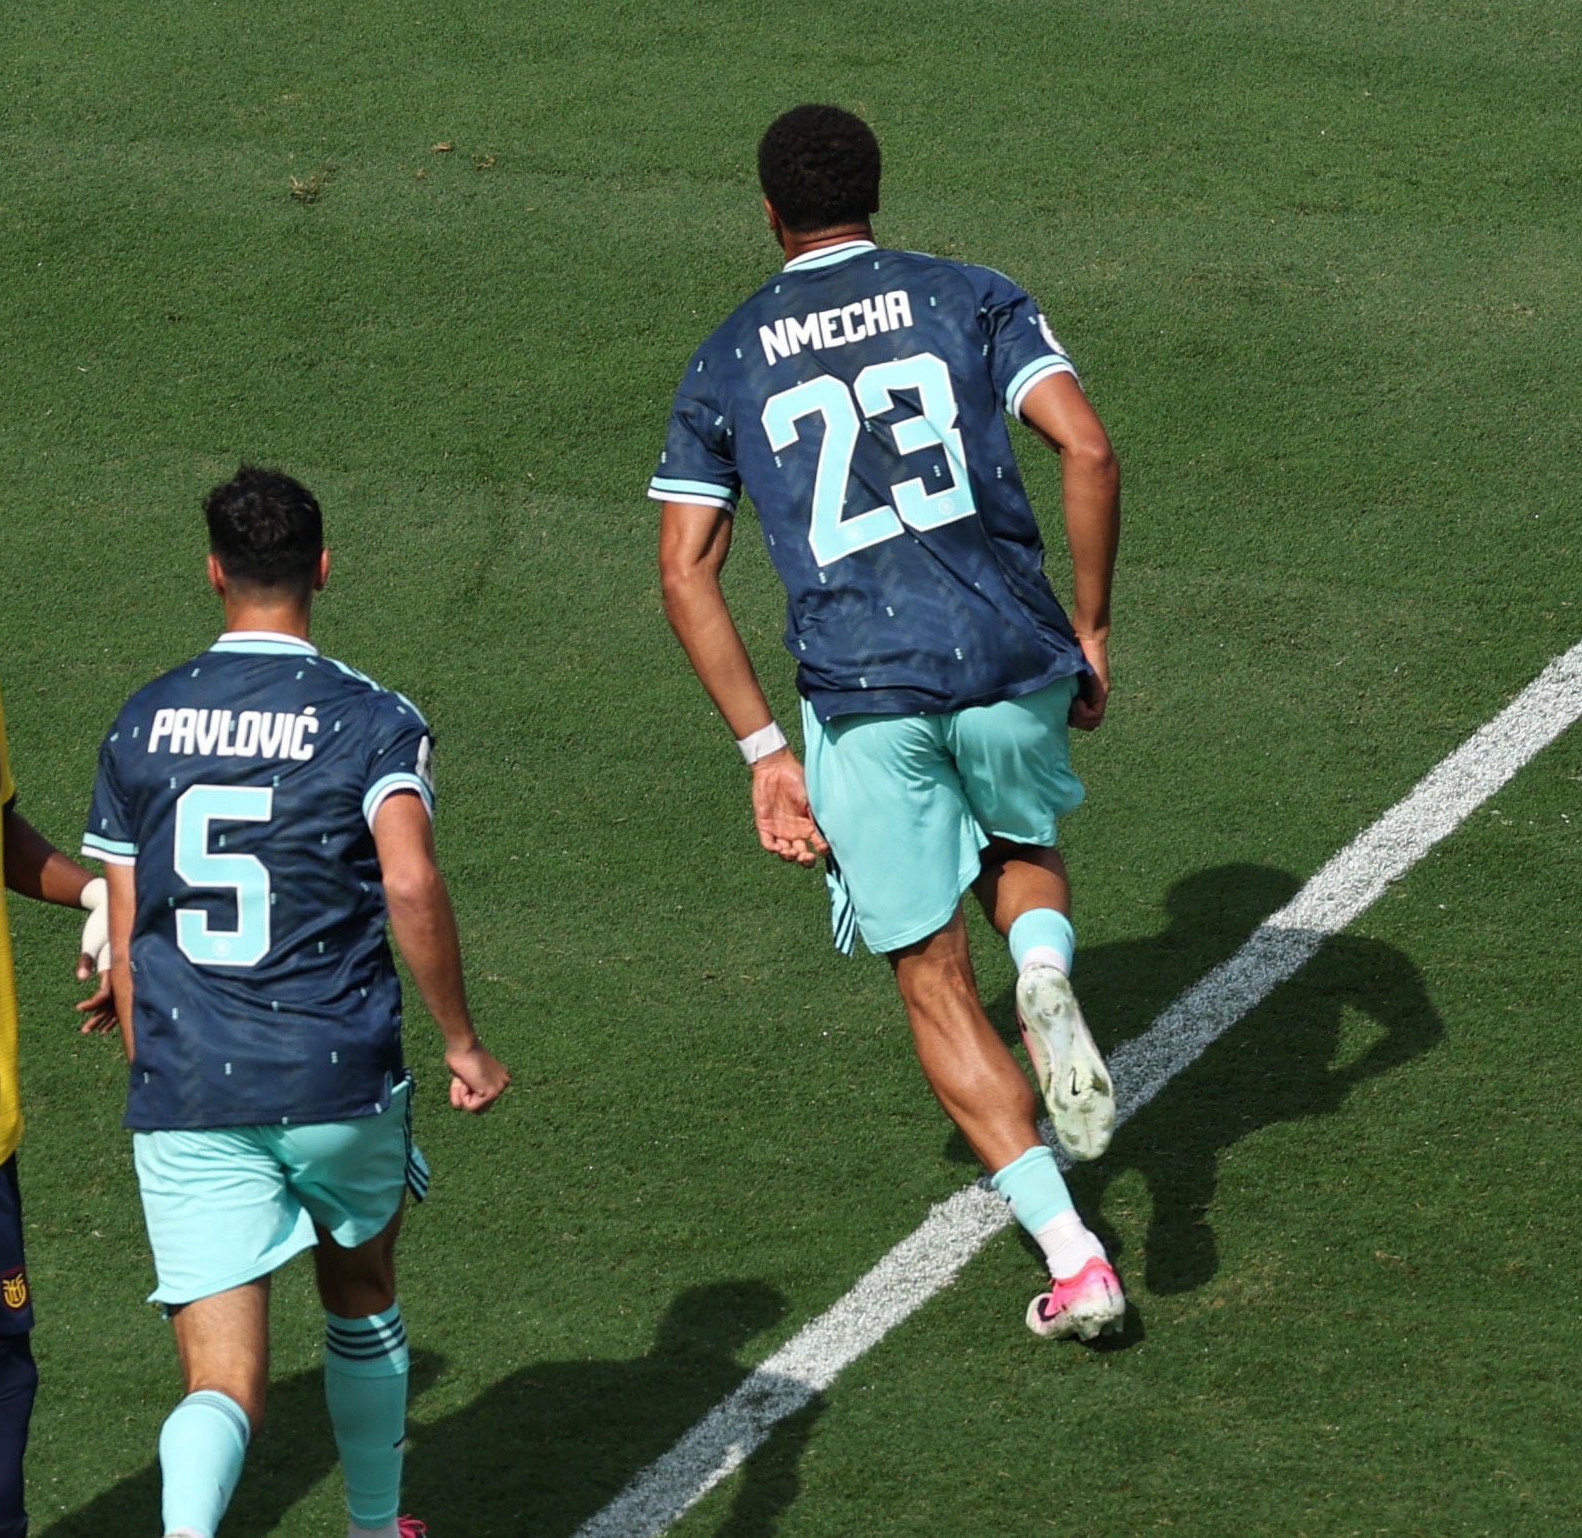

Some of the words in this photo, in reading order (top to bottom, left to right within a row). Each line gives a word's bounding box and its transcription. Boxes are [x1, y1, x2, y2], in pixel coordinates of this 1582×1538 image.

[759, 290, 913, 366] NMECHA
[761, 352, 976, 567] 23
[148, 706, 319, 761] PAVLOVIĆ
[174, 784, 274, 966] 5
